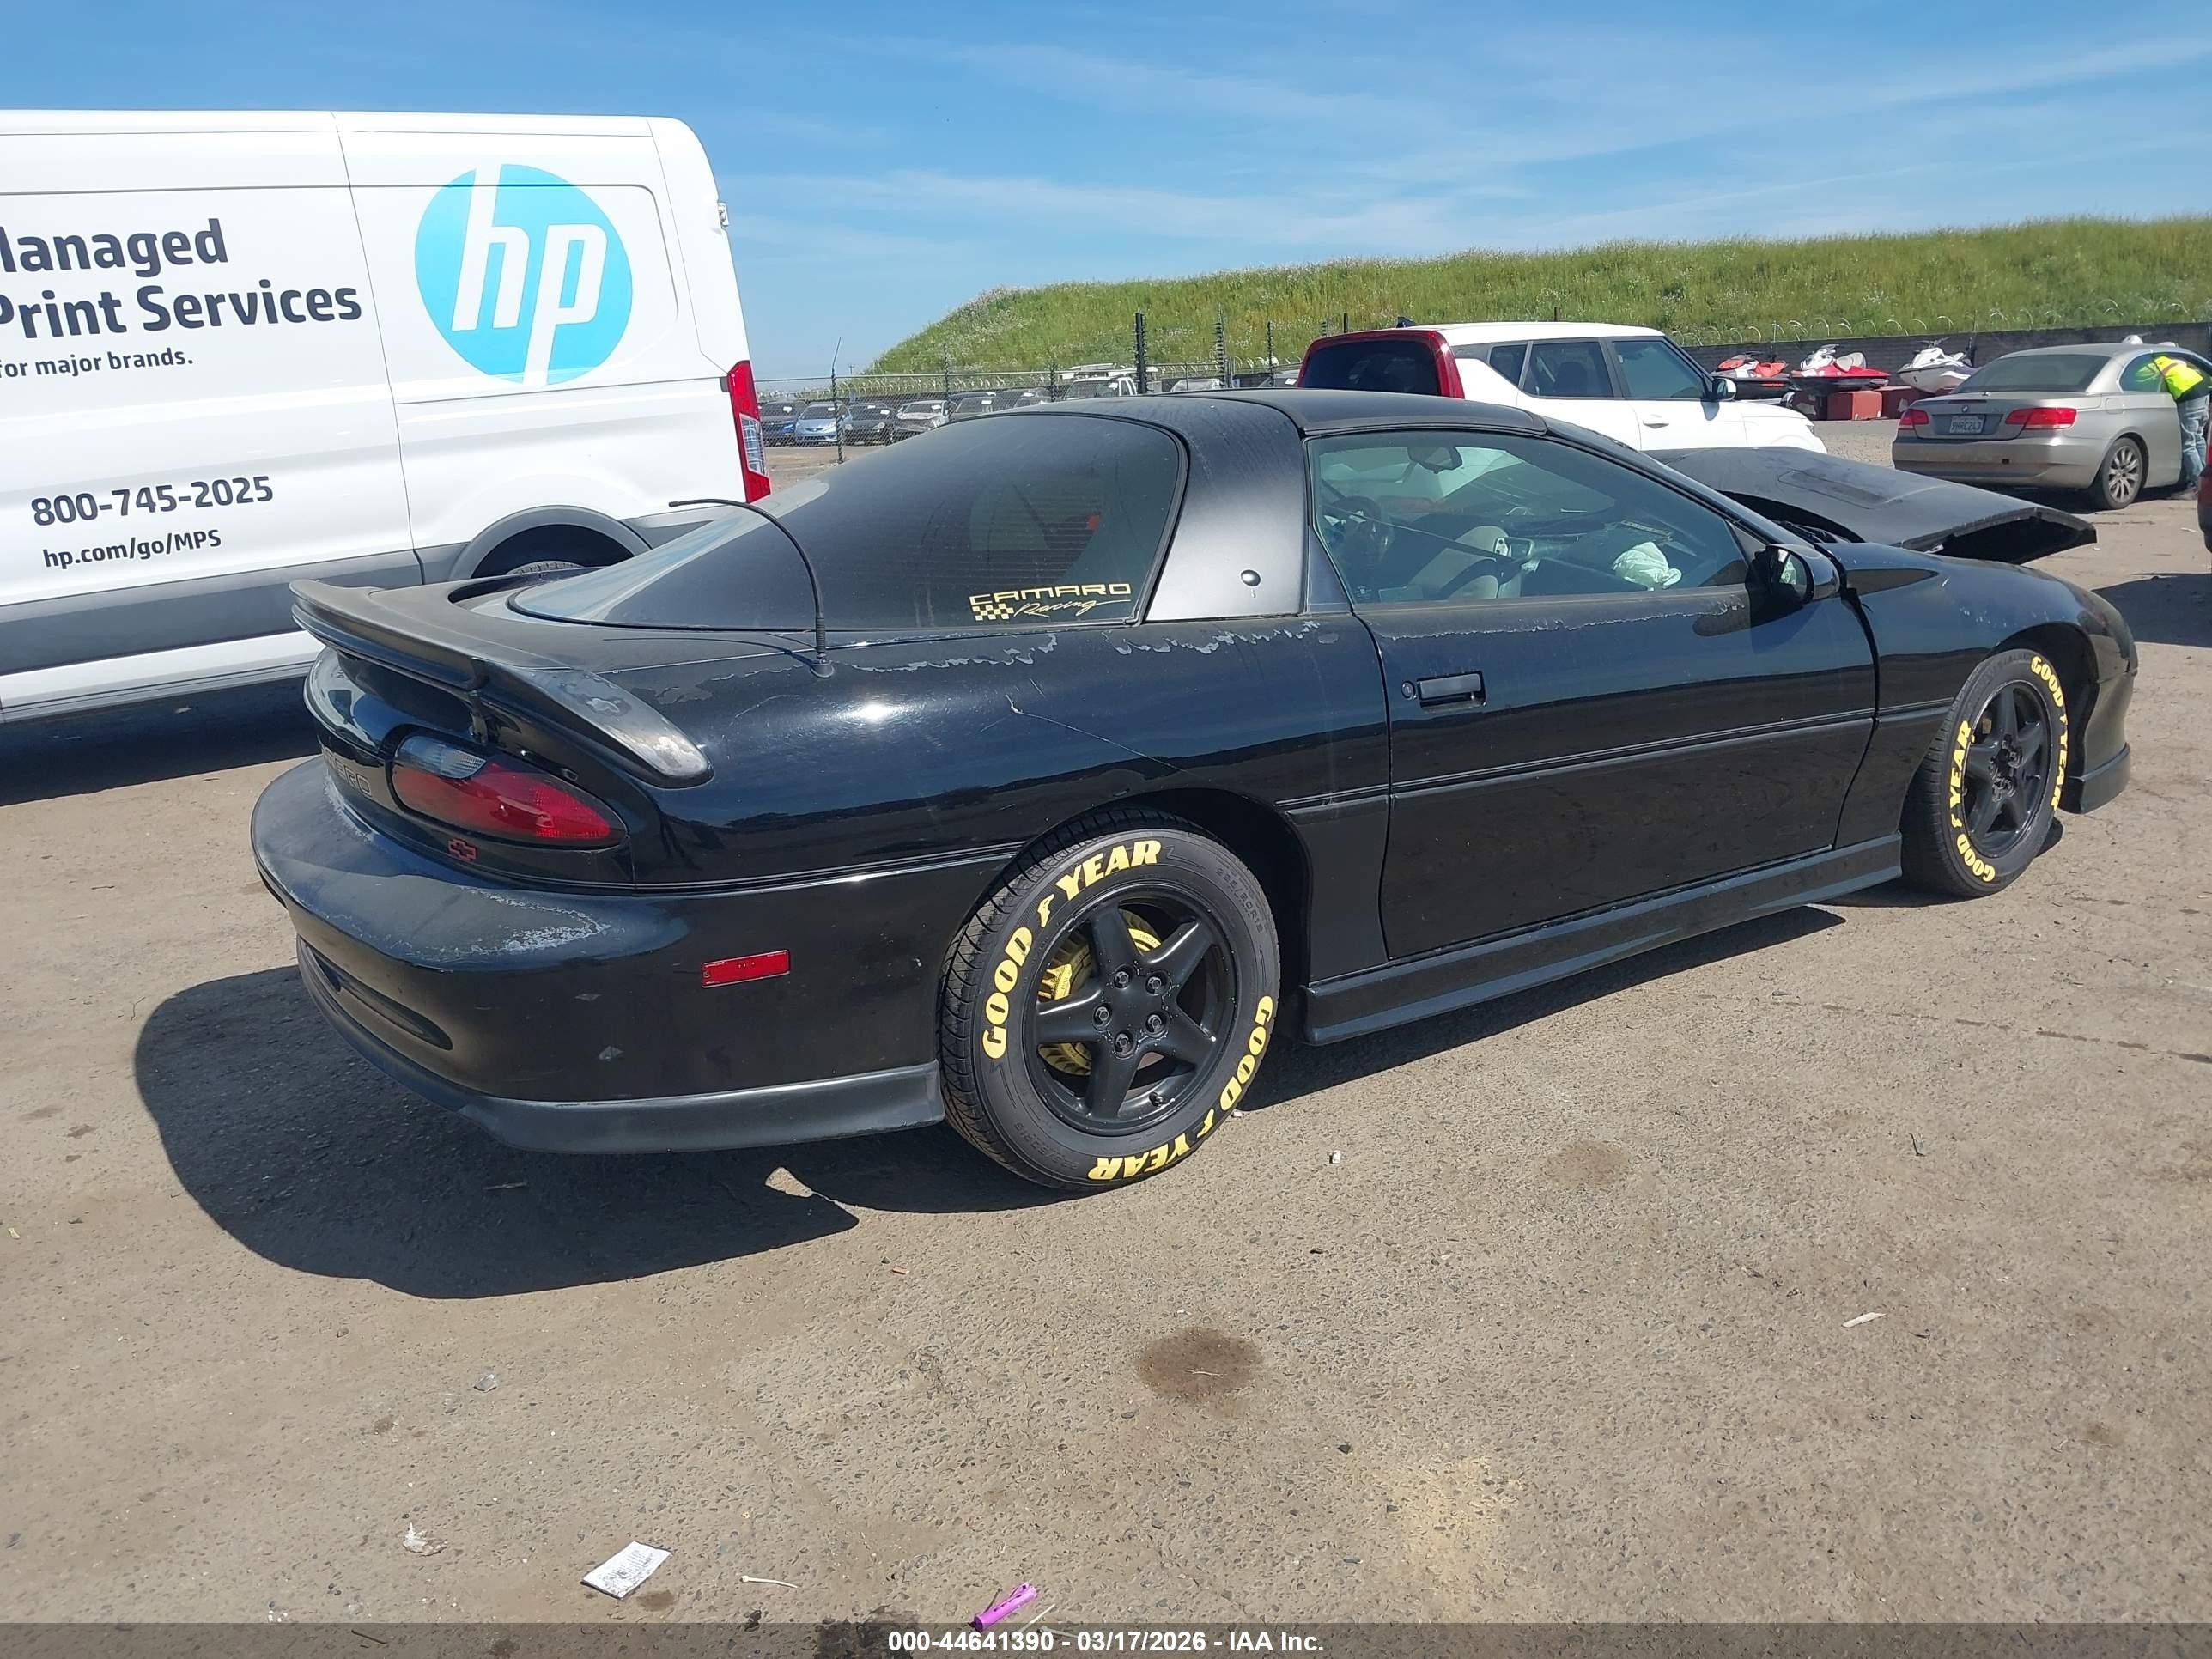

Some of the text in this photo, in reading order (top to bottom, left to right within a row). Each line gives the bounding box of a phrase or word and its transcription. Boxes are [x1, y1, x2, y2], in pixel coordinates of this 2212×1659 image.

[450, 165, 608, 386] hp
[137, 279, 362, 331] Services
[35, 353, 102, 377] major
[107, 347, 193, 370] brands.
[31, 476, 273, 526] 800-745-2025
[43, 529, 222, 569] hp.com/go/MPS
[969, 583, 1132, 605] CAMARO
[1013, 599, 1132, 618] Racing
[2030, 656, 2063, 708] GOOD
[1949, 720, 1996, 883] GOOD YEAR
[982, 839, 1163, 1060] GOOD YEAR
[1219, 995, 1275, 1111] GOOD
[1087, 1134, 1192, 1182] YEAR
